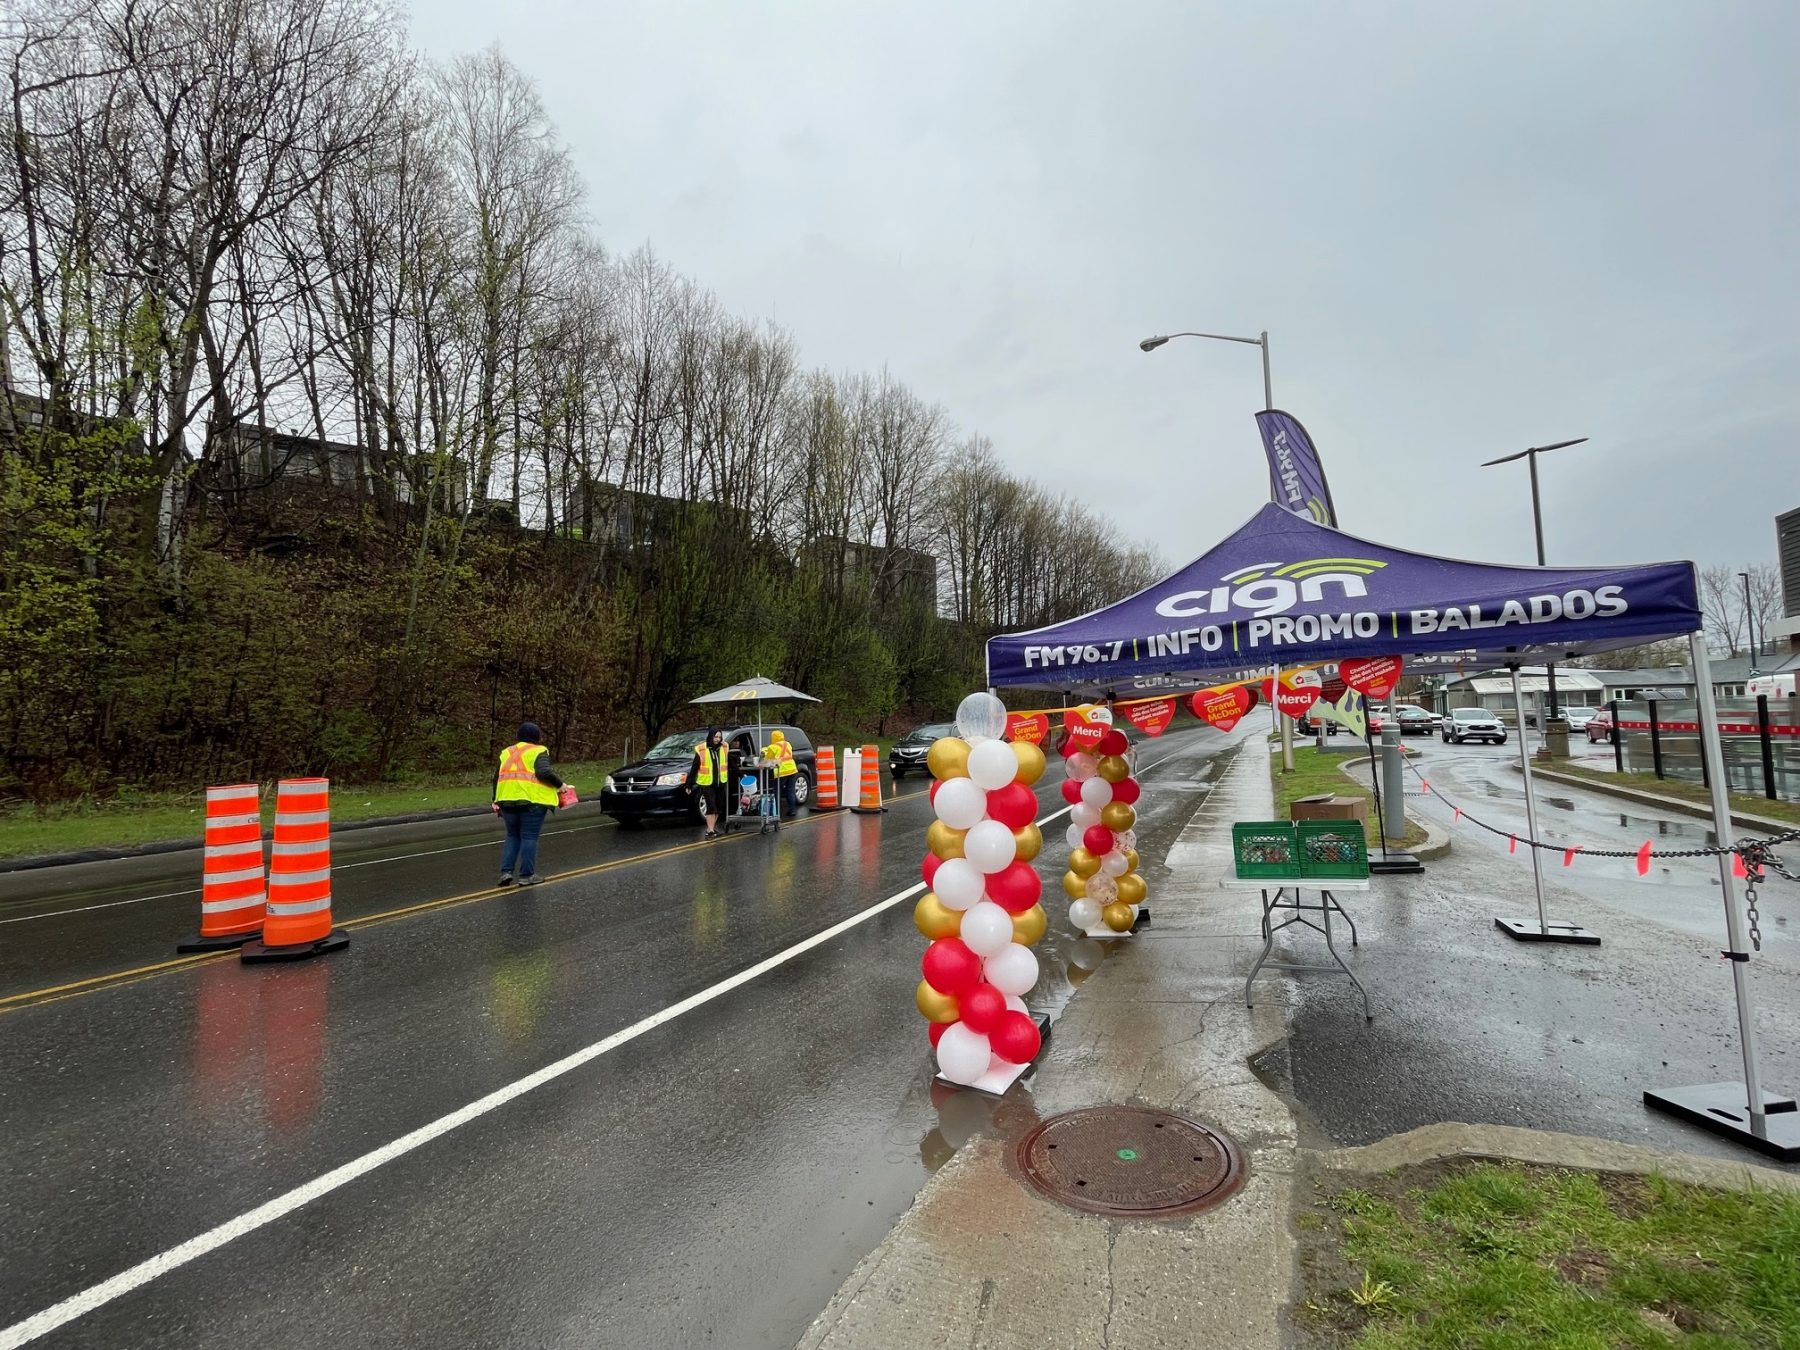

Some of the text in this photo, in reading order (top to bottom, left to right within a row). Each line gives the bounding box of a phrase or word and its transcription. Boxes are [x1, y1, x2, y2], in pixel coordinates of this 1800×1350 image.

[1155, 572, 1368, 617] cign
[1147, 625, 1223, 658] INFO
[1249, 611, 1379, 648] PROMO
[1411, 585, 1629, 635] BALADOS
[1277, 692, 1311, 704] Merci
[1207, 698, 1236, 713] Grand
[1208, 707, 1241, 722] McDon
[1014, 724, 1039, 735] Grand
[1073, 725, 1102, 738] Merci
[1014, 732, 1042, 742] McDon
